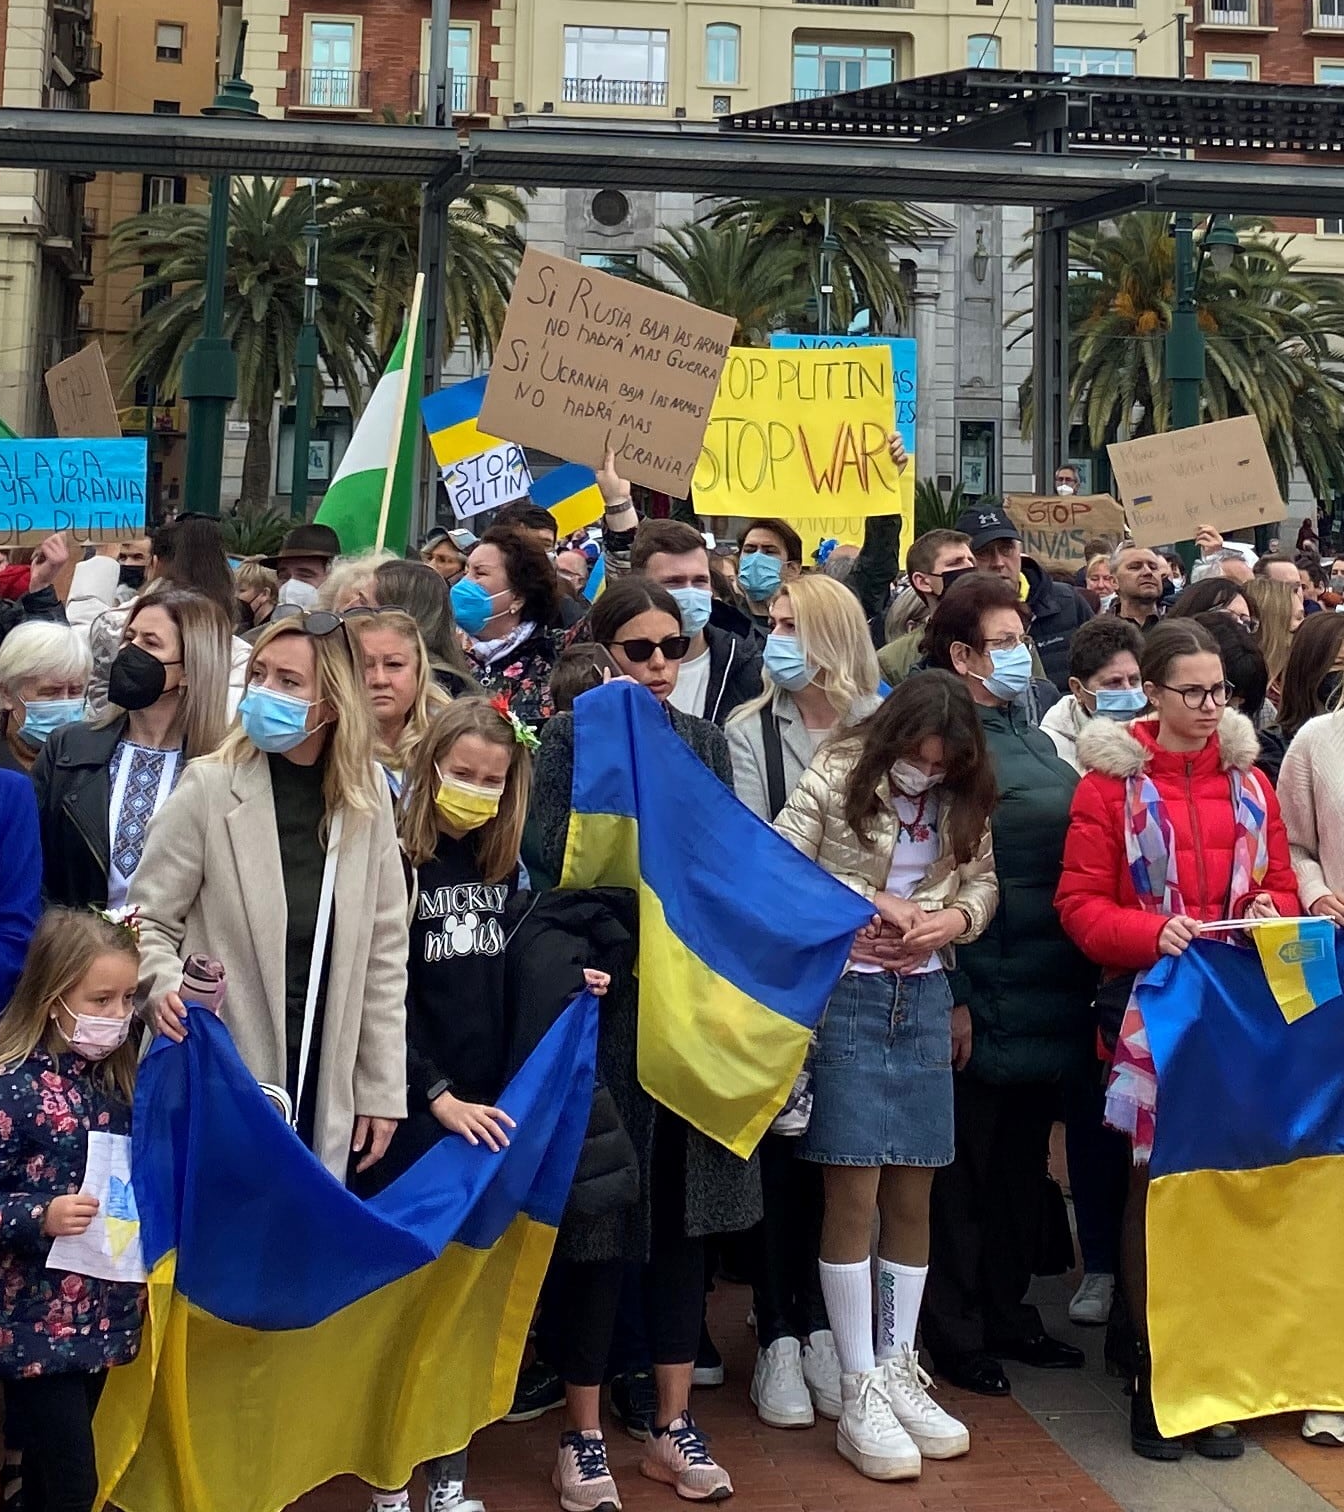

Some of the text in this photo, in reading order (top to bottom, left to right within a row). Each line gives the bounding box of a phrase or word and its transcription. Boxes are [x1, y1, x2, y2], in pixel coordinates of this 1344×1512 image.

[544, 317, 570, 338] NO
[629, 343, 662, 364] MAS
[639, 317, 670, 341] BAJA
[778, 359, 885, 401] PUTIN
[514, 381, 546, 408] NO
[617, 412, 653, 435] MAS
[618, 383, 645, 404] BAJA
[669, 396, 706, 420] ARMAS
[455, 446, 518, 488] STOP
[797, 420, 897, 496] WAR
[49, 478, 145, 505] UCRANIA
[455, 469, 523, 515] PUTIN
[53, 509, 138, 543] PUTIN
[1026, 500, 1093, 527] STOP
